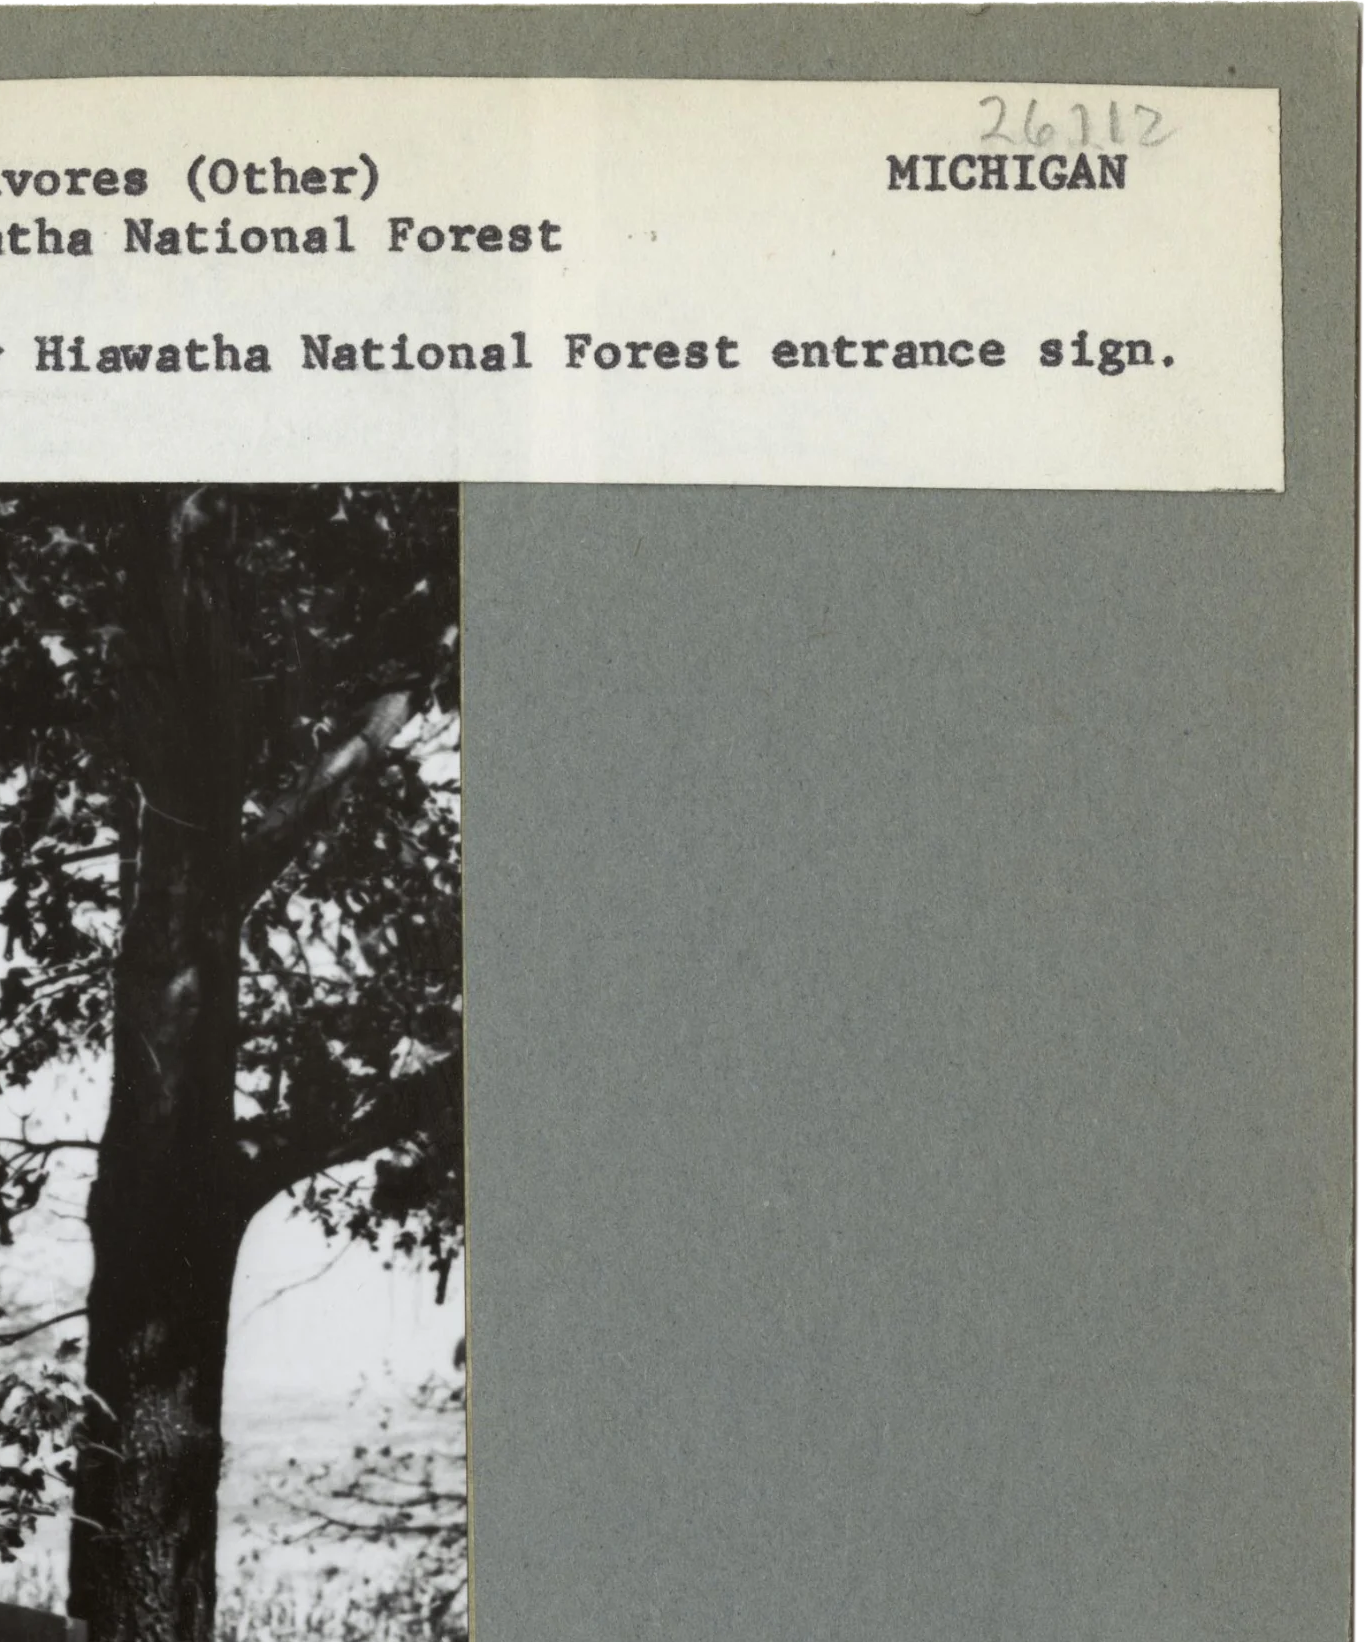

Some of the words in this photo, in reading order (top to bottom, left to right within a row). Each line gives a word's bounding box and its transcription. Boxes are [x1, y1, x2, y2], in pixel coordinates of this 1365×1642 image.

[188, 153, 378, 202] (Other)
[887, 153, 1127, 191] MICHIGAN
[124, 215, 354, 255] National
[389, 217, 561, 252] Forest
[35, 333, 271, 373] Hiawatha
[301, 331, 531, 371] National
[565, 334, 739, 369] Forest
[772, 336, 1005, 368] entrance
[1040, 330, 1173, 376] sign.
